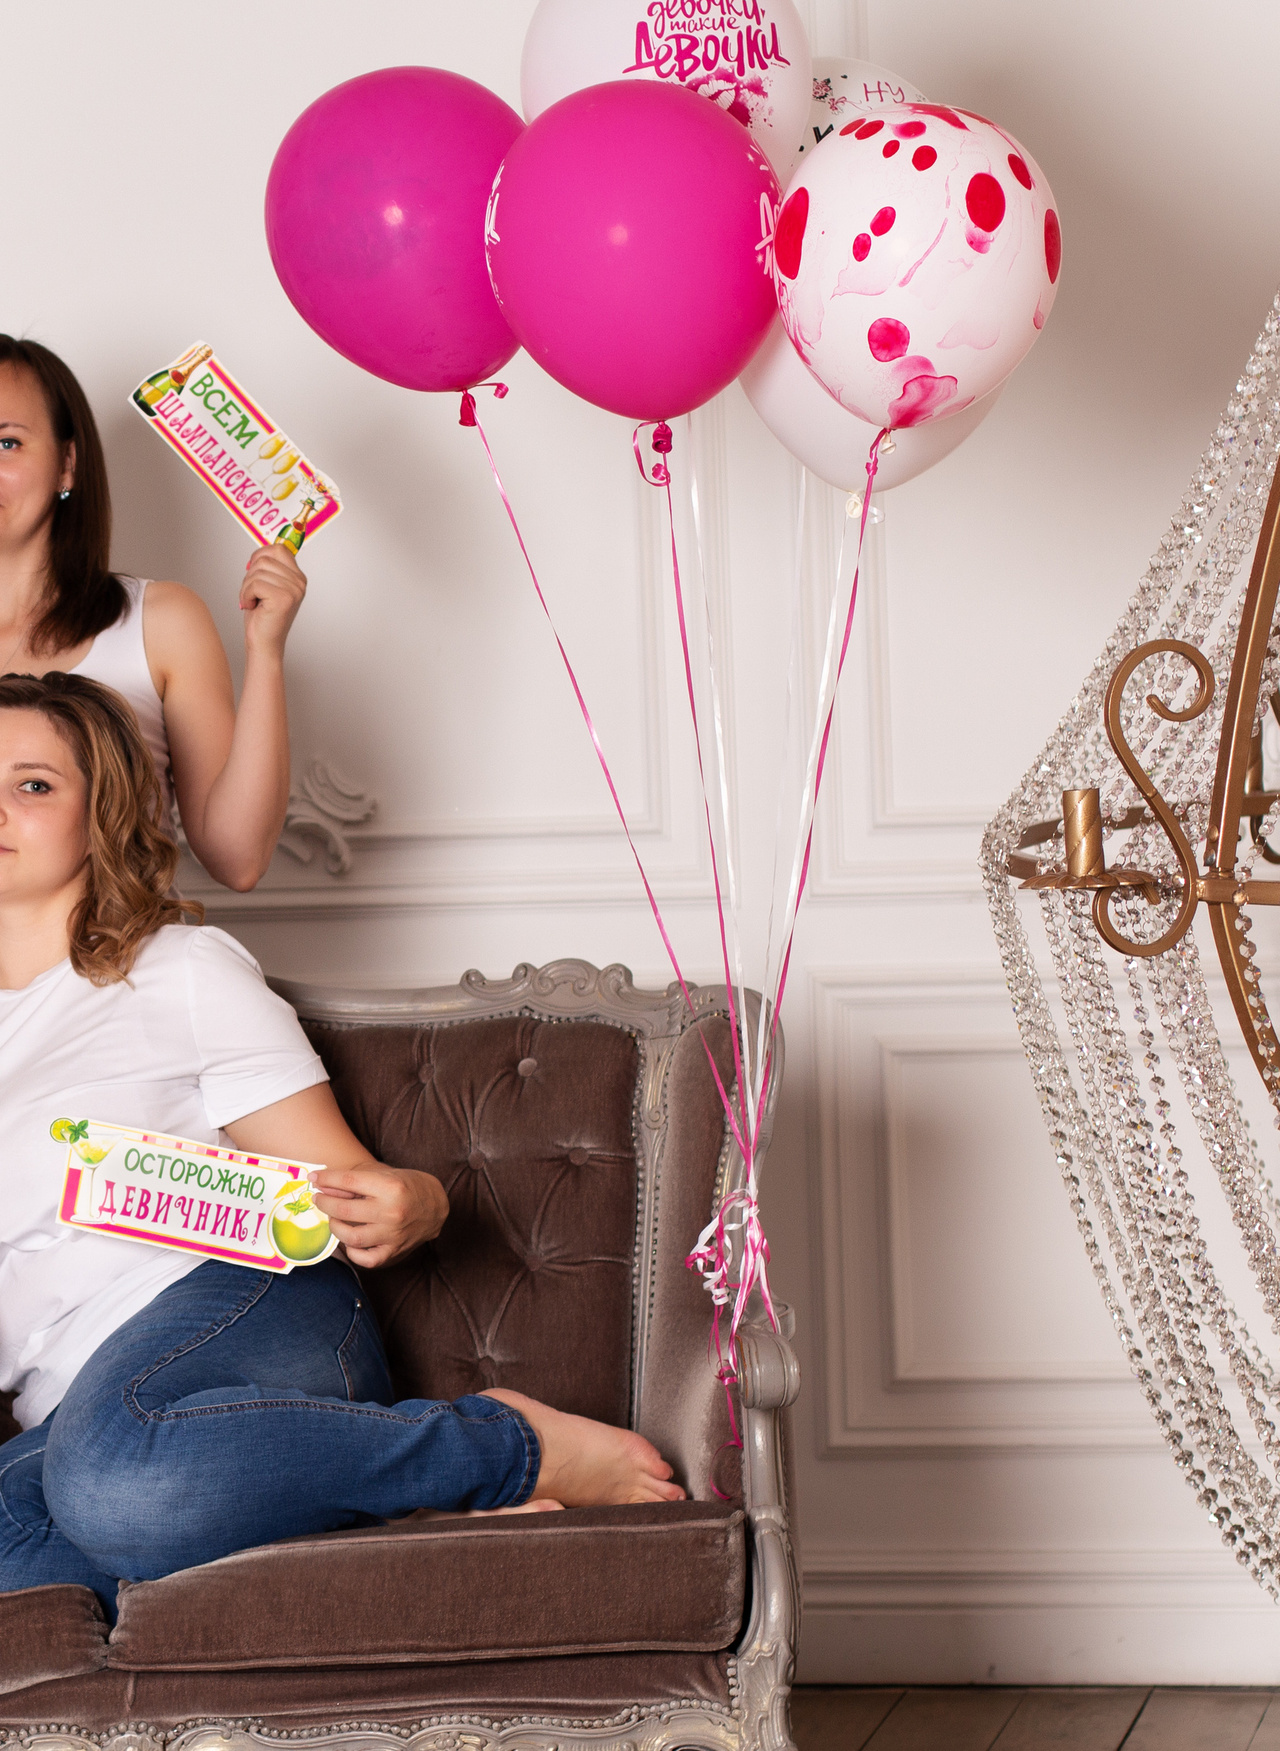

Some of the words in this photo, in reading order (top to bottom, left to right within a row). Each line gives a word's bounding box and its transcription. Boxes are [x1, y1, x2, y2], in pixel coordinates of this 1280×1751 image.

[189, 372, 259, 449] ВСЕМ
[154, 391, 289, 535] ШАМПАНСКОГО!
[124, 1148, 266, 1204] ОСТОРОЖНО,
[98, 1179, 266, 1246] ДЕВИЧНИК!
